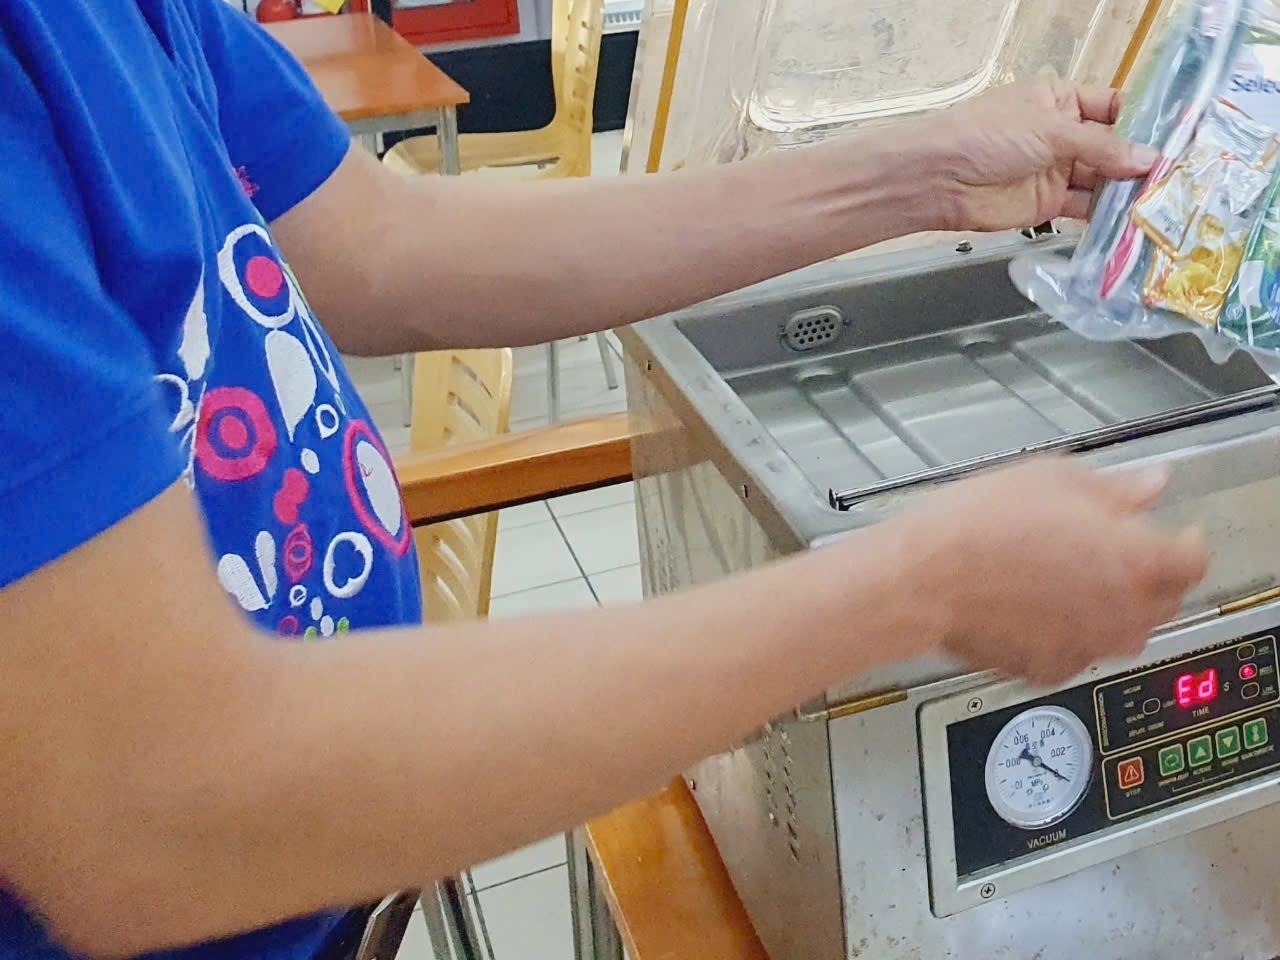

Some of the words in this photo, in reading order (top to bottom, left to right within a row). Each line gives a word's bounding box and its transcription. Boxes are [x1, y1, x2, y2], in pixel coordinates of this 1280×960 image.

[1177, 667, 1218, 707] Ed
[1192, 706, 1210, 718] TIME
[1026, 828, 1067, 849] VACUUM
